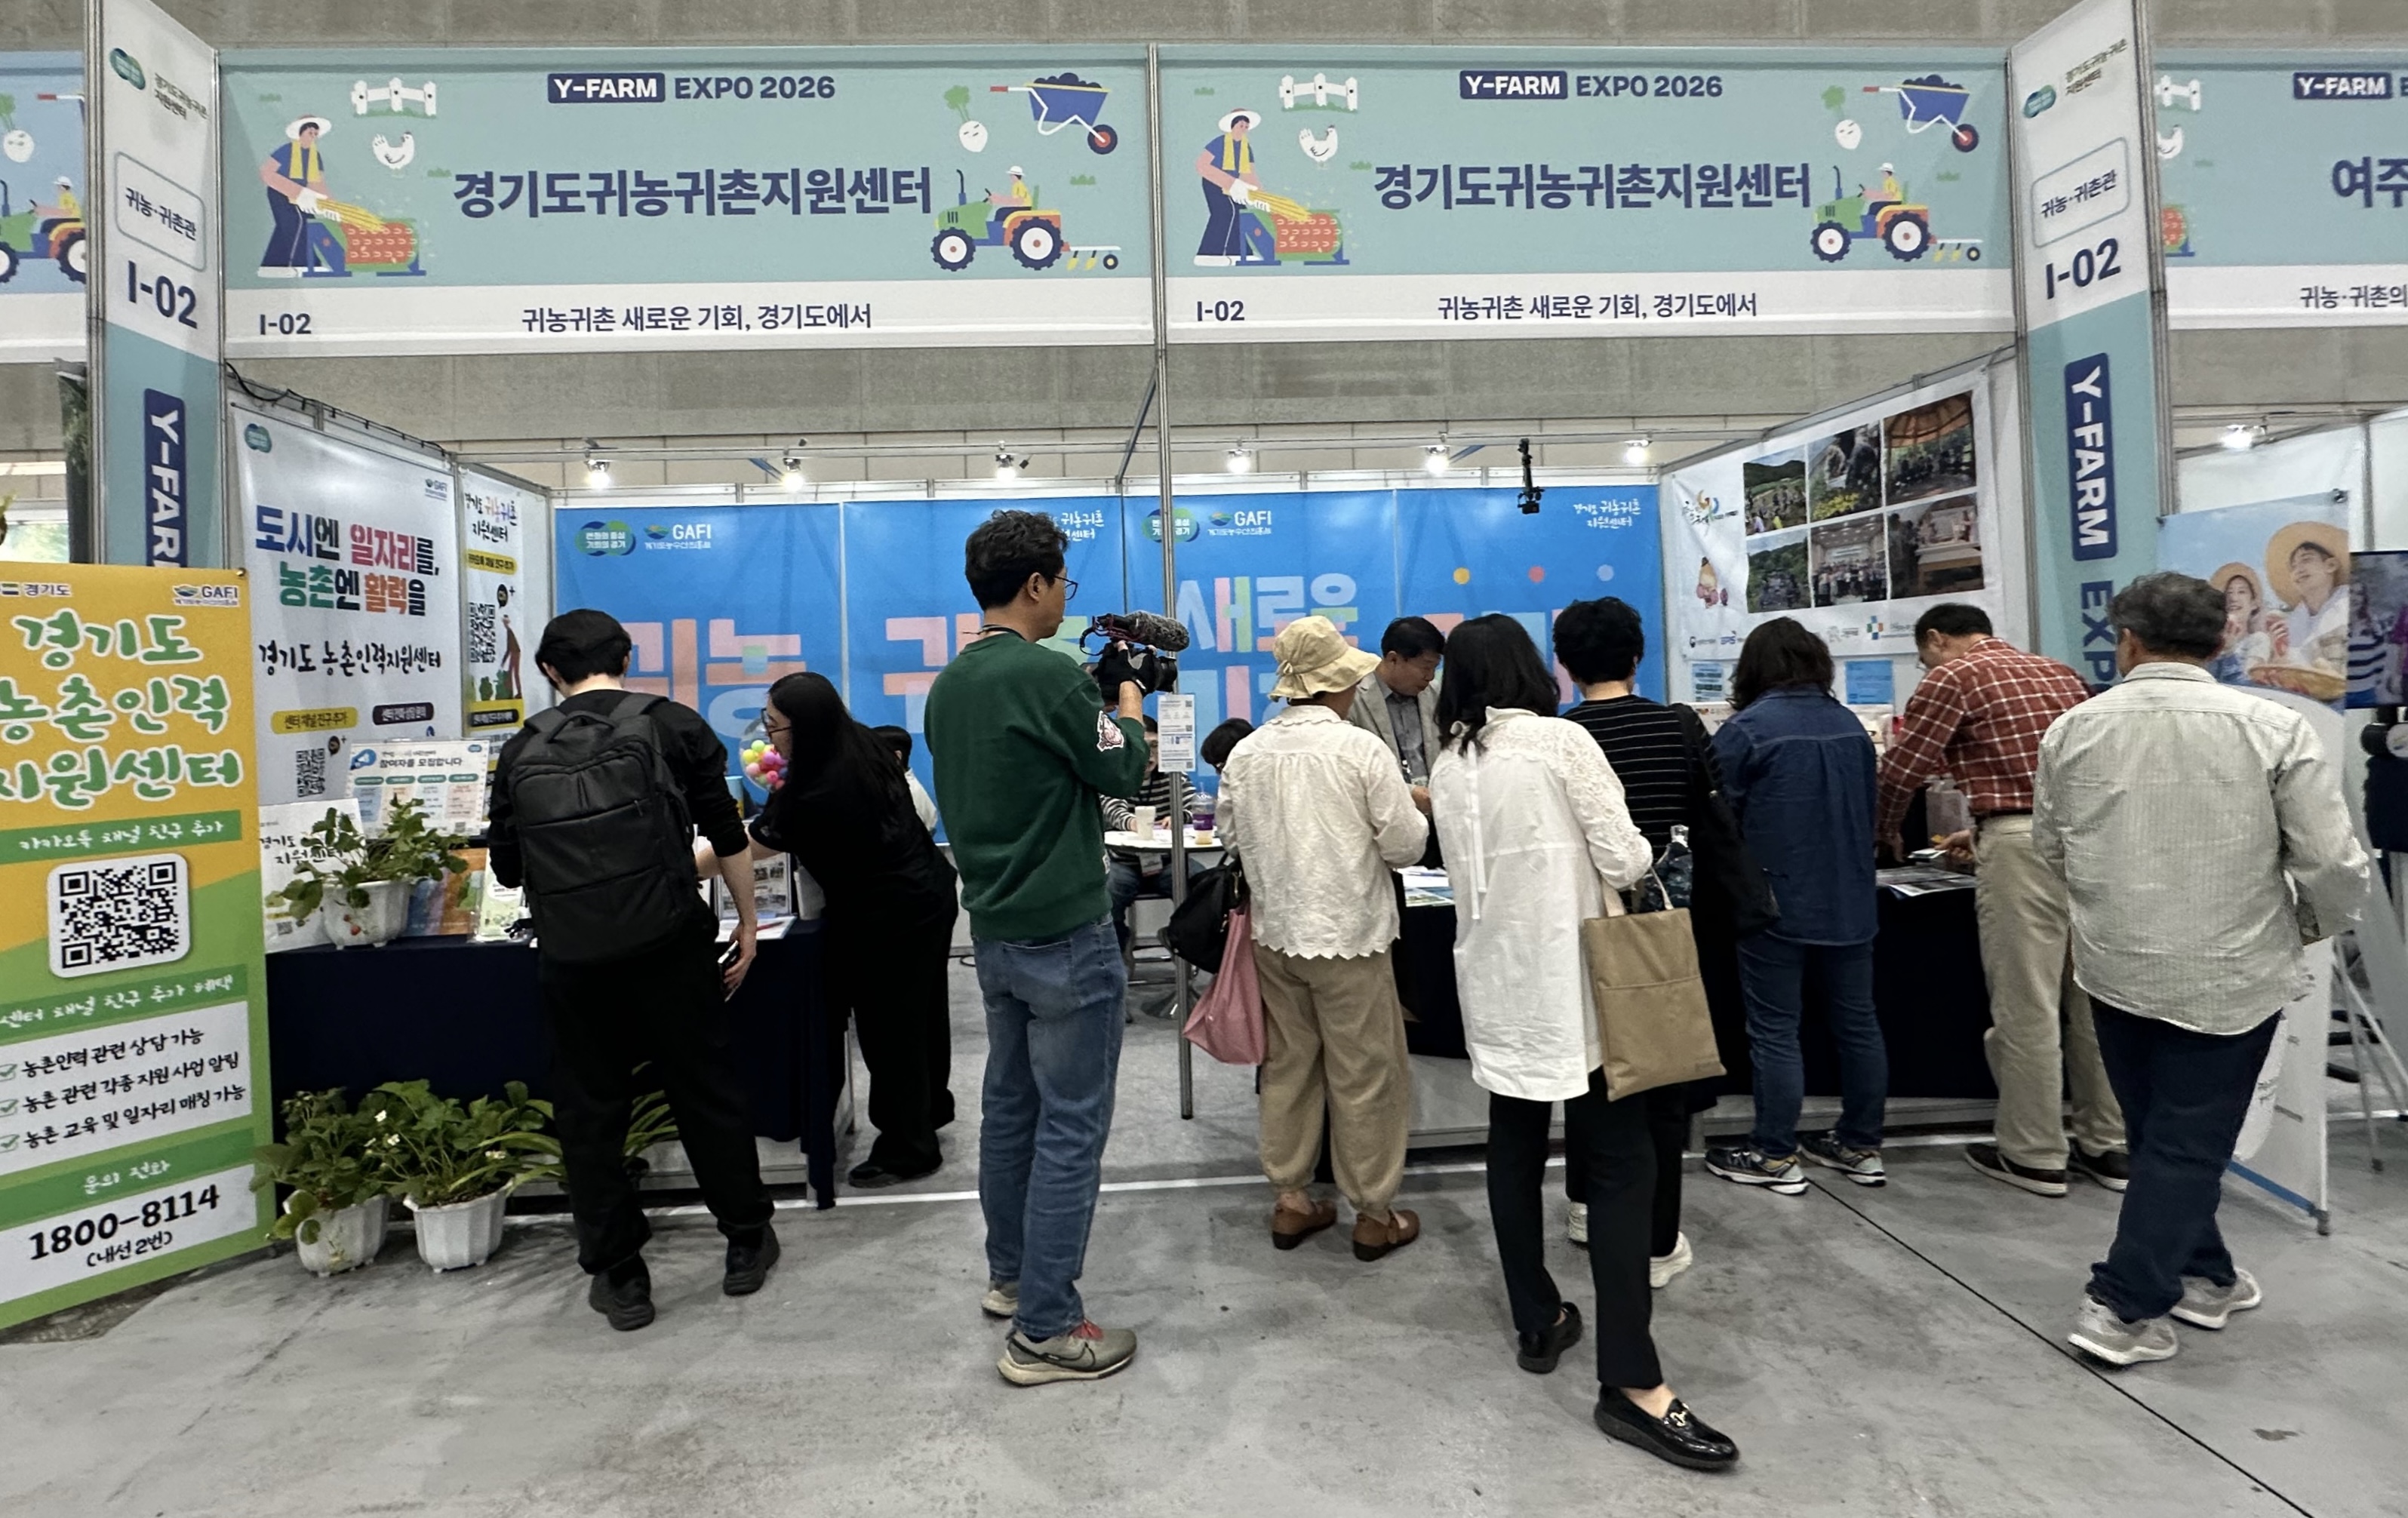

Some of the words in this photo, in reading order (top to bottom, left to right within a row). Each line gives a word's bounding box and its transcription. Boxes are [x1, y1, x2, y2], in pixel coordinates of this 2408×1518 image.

[554, 78, 657, 98] Y-FARM
[675, 77, 753, 100] EXPO
[760, 76, 835, 99] 2026
[1466, 77, 1561, 96] Y-FARM
[1576, 75, 1648, 97] EXPO
[1654, 75, 1723, 97] 2026
[2298, 77, 2386, 97] Y-FARM
[454, 167, 932, 218] 경기도귀농귀촌지원센터
[1374, 163, 1810, 210] 경기도귀농귀촌지원센터
[2040, 169, 2117, 219] 귀농·귀촌관
[125, 187, 196, 241] 귀농·귀촌관
[2046, 238, 2121, 300] I-02
[128, 260, 198, 330] I-02
[1197, 300, 1245, 321] I-02
[1438, 295, 1524, 320] 귀농귀촌
[1529, 294, 1593, 318] 새로운
[1598, 293, 1647, 320] 기회,
[1653, 292, 1757, 318] 경기도에서
[259, 313, 312, 336] I-02
[522, 308, 617, 332] 귀농귀촌
[622, 306, 690, 331] 새로운
[698, 304, 751, 332] 기회,
[757, 303, 872, 330] 경기도에서
[2071, 365, 2110, 548] Y-FARM
[151, 410, 180, 567] Y-FAR
[1600, 498, 1641, 515] 귀농귀촌
[672, 524, 712, 539] GAFI
[1061, 510, 1104, 528] 귀농귀촌
[1235, 511, 1272, 527] GAFI
[1587, 516, 1632, 529] 지원센터
[255, 505, 340, 561] 도시엔
[349, 524, 439, 576] 일자리를,
[25, 584, 70, 595] 경기도
[201, 587, 238, 598] GAFI
[279, 561, 361, 611] 농촌엔
[364, 572, 426, 616] 활력을
[14, 610, 201, 668] 경기도
[2080, 580, 2117, 693] EXP
[259, 640, 317, 676] 경기도
[322, 640, 441, 677] 농촌인력지원센터
[0, 676, 229, 740] 농촌인력
[19, 829, 93, 850] 카카오톡
[102, 825, 140, 844] 채널
[149, 823, 183, 840] 친구
[192, 820, 223, 837] 추가
[259, 835, 296, 849] 경기도
[53, 996, 95, 1018] 채널
[105, 991, 141, 1009] 친구
[150, 985, 185, 1003] 추가
[194, 974, 233, 993] 혜택
[21, 1048, 88, 1078] 농촌인력
[91, 1042, 126, 1065] 관련
[129, 1034, 168, 1056] 상담
[170, 1028, 205, 1046] 가능
[22, 1091, 58, 1114] 농촌
[61, 1082, 97, 1105] 관련
[100, 1074, 134, 1096] 각종
[137, 1066, 170, 1086] 지원
[173, 1058, 205, 1078] 사업
[208, 1051, 240, 1074] 알림
[23, 1126, 59, 1148] 농촌
[63, 1117, 99, 1138] 교육
[102, 1111, 119, 1129] 및
[123, 1099, 176, 1125] 일자리
[179, 1089, 211, 1110] 매칭
[212, 1083, 247, 1102] 가능
[84, 1172, 120, 1195] 문의
[129, 1160, 171, 1180] 전화
[28, 1184, 221, 1261] 1800-8114
[86, 1244, 132, 1268] (내선
[135, 1231, 174, 1253] 2번)
